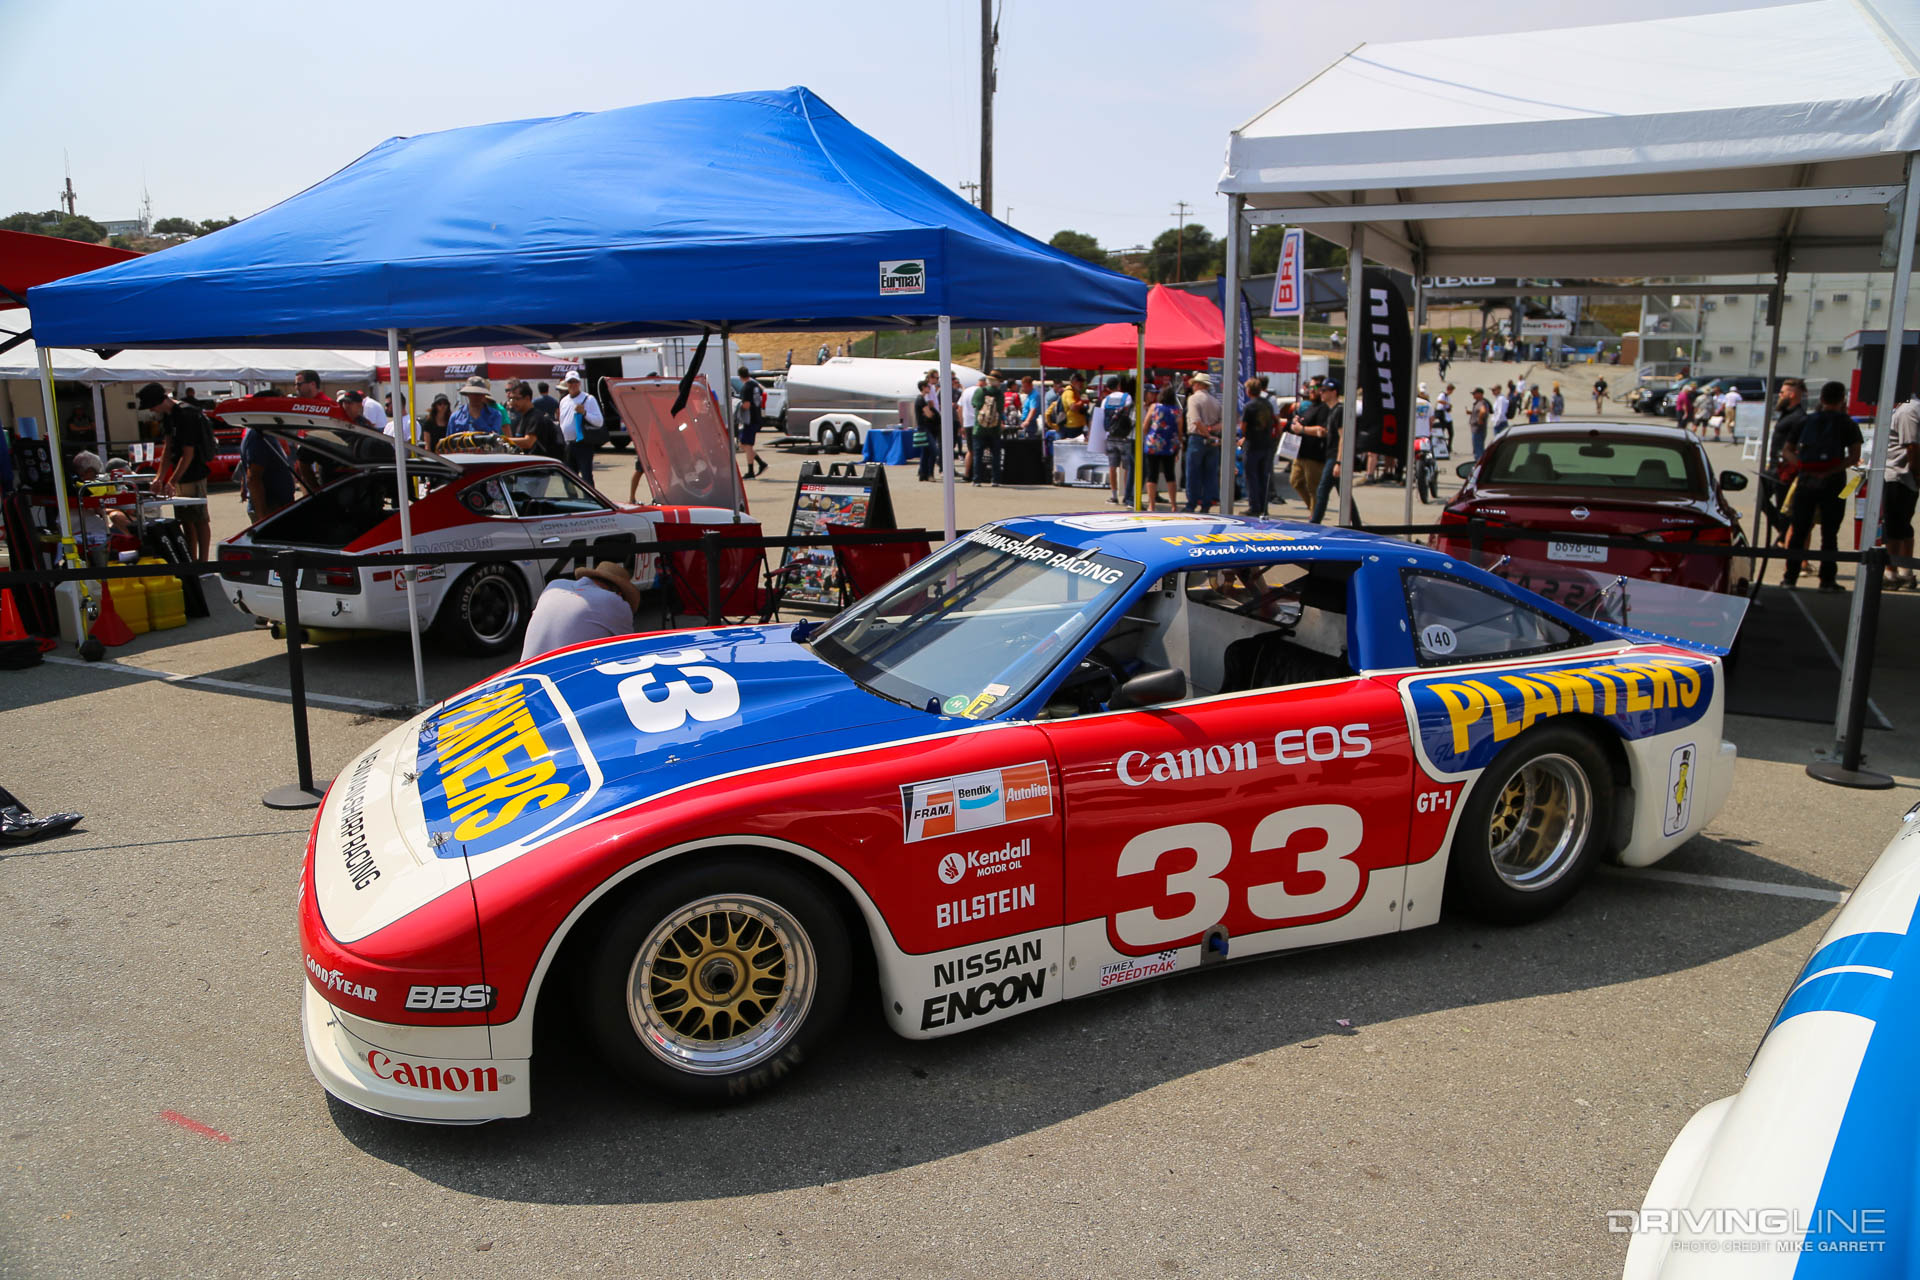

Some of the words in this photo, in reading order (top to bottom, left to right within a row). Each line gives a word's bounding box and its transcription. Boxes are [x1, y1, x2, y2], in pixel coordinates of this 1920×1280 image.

[881, 275, 921, 288] Eurmax
[444, 364, 477, 374] STILLEN
[1370, 288, 1399, 446] nismo
[292, 403, 331, 414] DATSUN
[1160, 533, 1297, 546] PLANTERS
[1188, 545, 1239, 557] Paul
[1240, 544, 1323, 554] Newman
[1045, 554, 1124, 584] RACING
[1427, 632, 1450, 648] 140
[594, 648, 741, 734] 33
[1427, 659, 1701, 754] PLANTERS
[436, 683, 570, 841] PLANTERS
[1117, 741, 1258, 786] Canon
[1274, 723, 1372, 765] EOS
[958, 784, 992, 799] Bendix
[1006, 783, 1048, 802] Autolite
[1416, 790, 1452, 813] GT-1
[913, 804, 950, 819] FRAM
[341, 834, 381, 891] RACING
[967, 838, 1031, 868] Kendall
[977, 863, 1007, 877] MOTOR
[1008, 860, 1022, 871] OIL
[1115, 804, 1364, 946] 33
[936, 883, 1036, 929] BILSTEIN
[934, 938, 1043, 988] NISSAN
[1101, 960, 1176, 987] SPEEDTRAK
[1102, 960, 1135, 974] TIMEX
[405, 984, 493, 1011] BBS
[920, 967, 1047, 1031] ENCON
[367, 1050, 499, 1092] Canon
